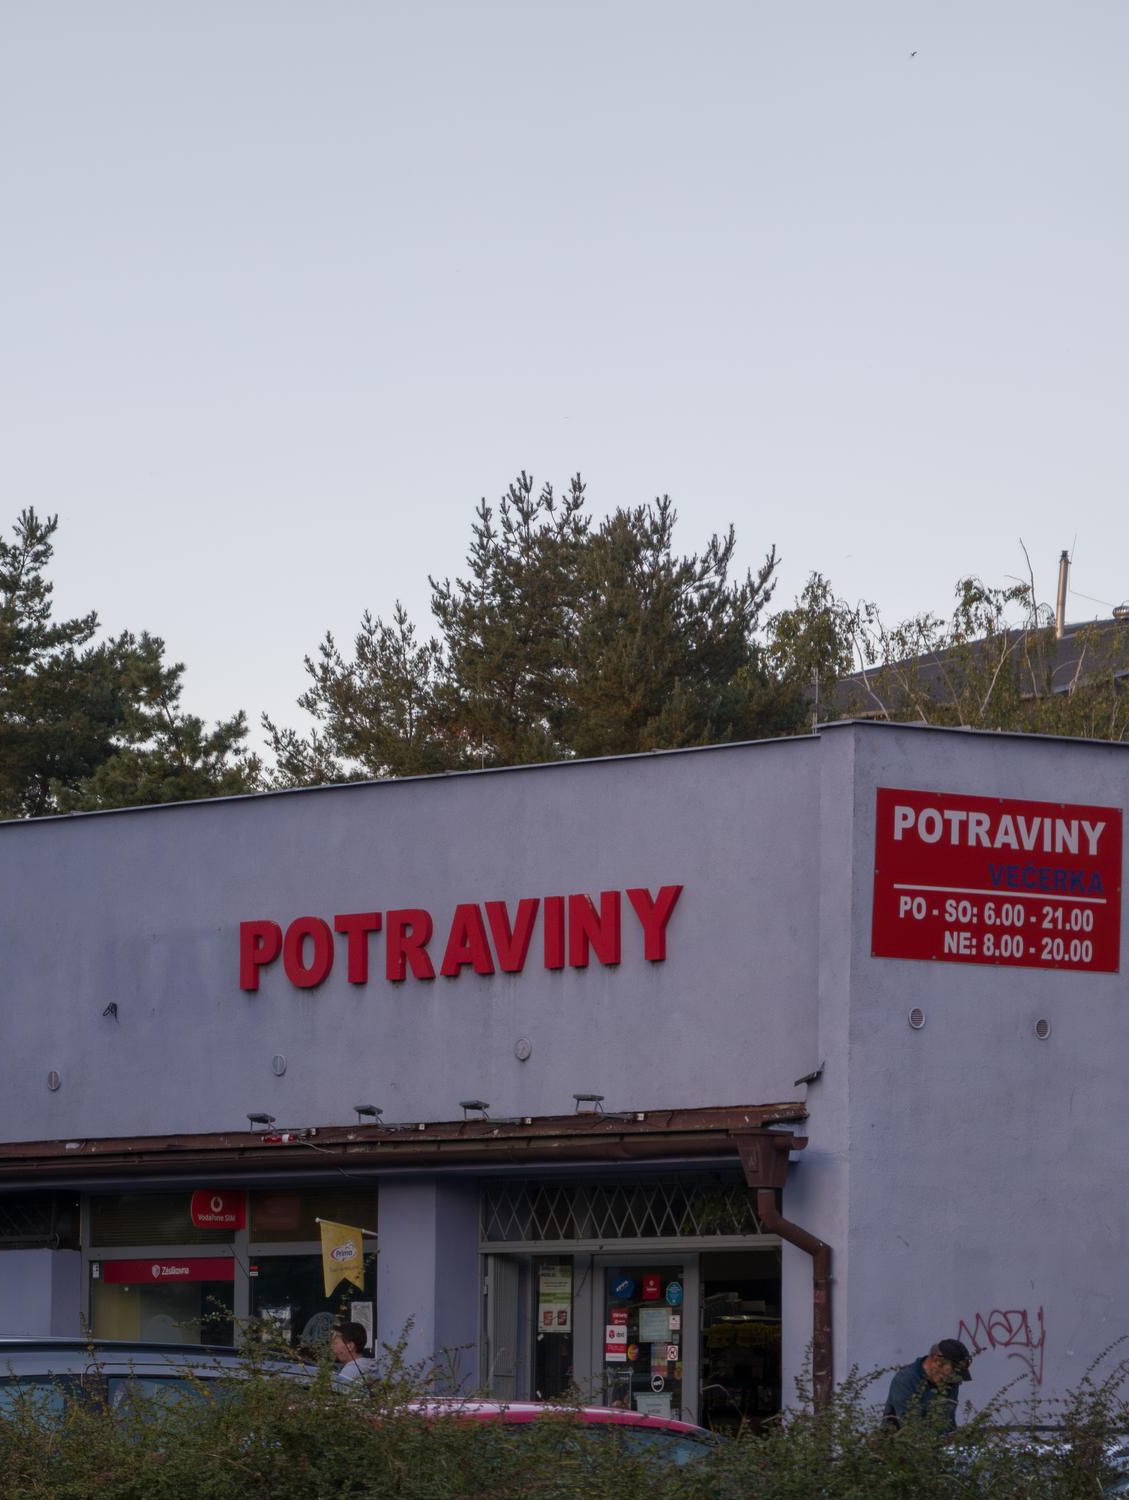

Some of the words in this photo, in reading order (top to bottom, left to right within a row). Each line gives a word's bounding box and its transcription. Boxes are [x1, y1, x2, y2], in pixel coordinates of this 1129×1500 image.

[893, 805, 1107, 856] POTRAVINY
[988, 861, 1104, 894] VEČERKA
[899, 896, 927, 920] PO
[944, 899, 978, 924] SO:
[984, 902, 1025, 928] 6.00
[1042, 906, 1094, 932] 21.00
[240, 885, 684, 991] POTRAVINY
[944, 931, 977, 955] NE:
[983, 933, 1024, 958] 8.00
[1041, 937, 1093, 963] 20.00
